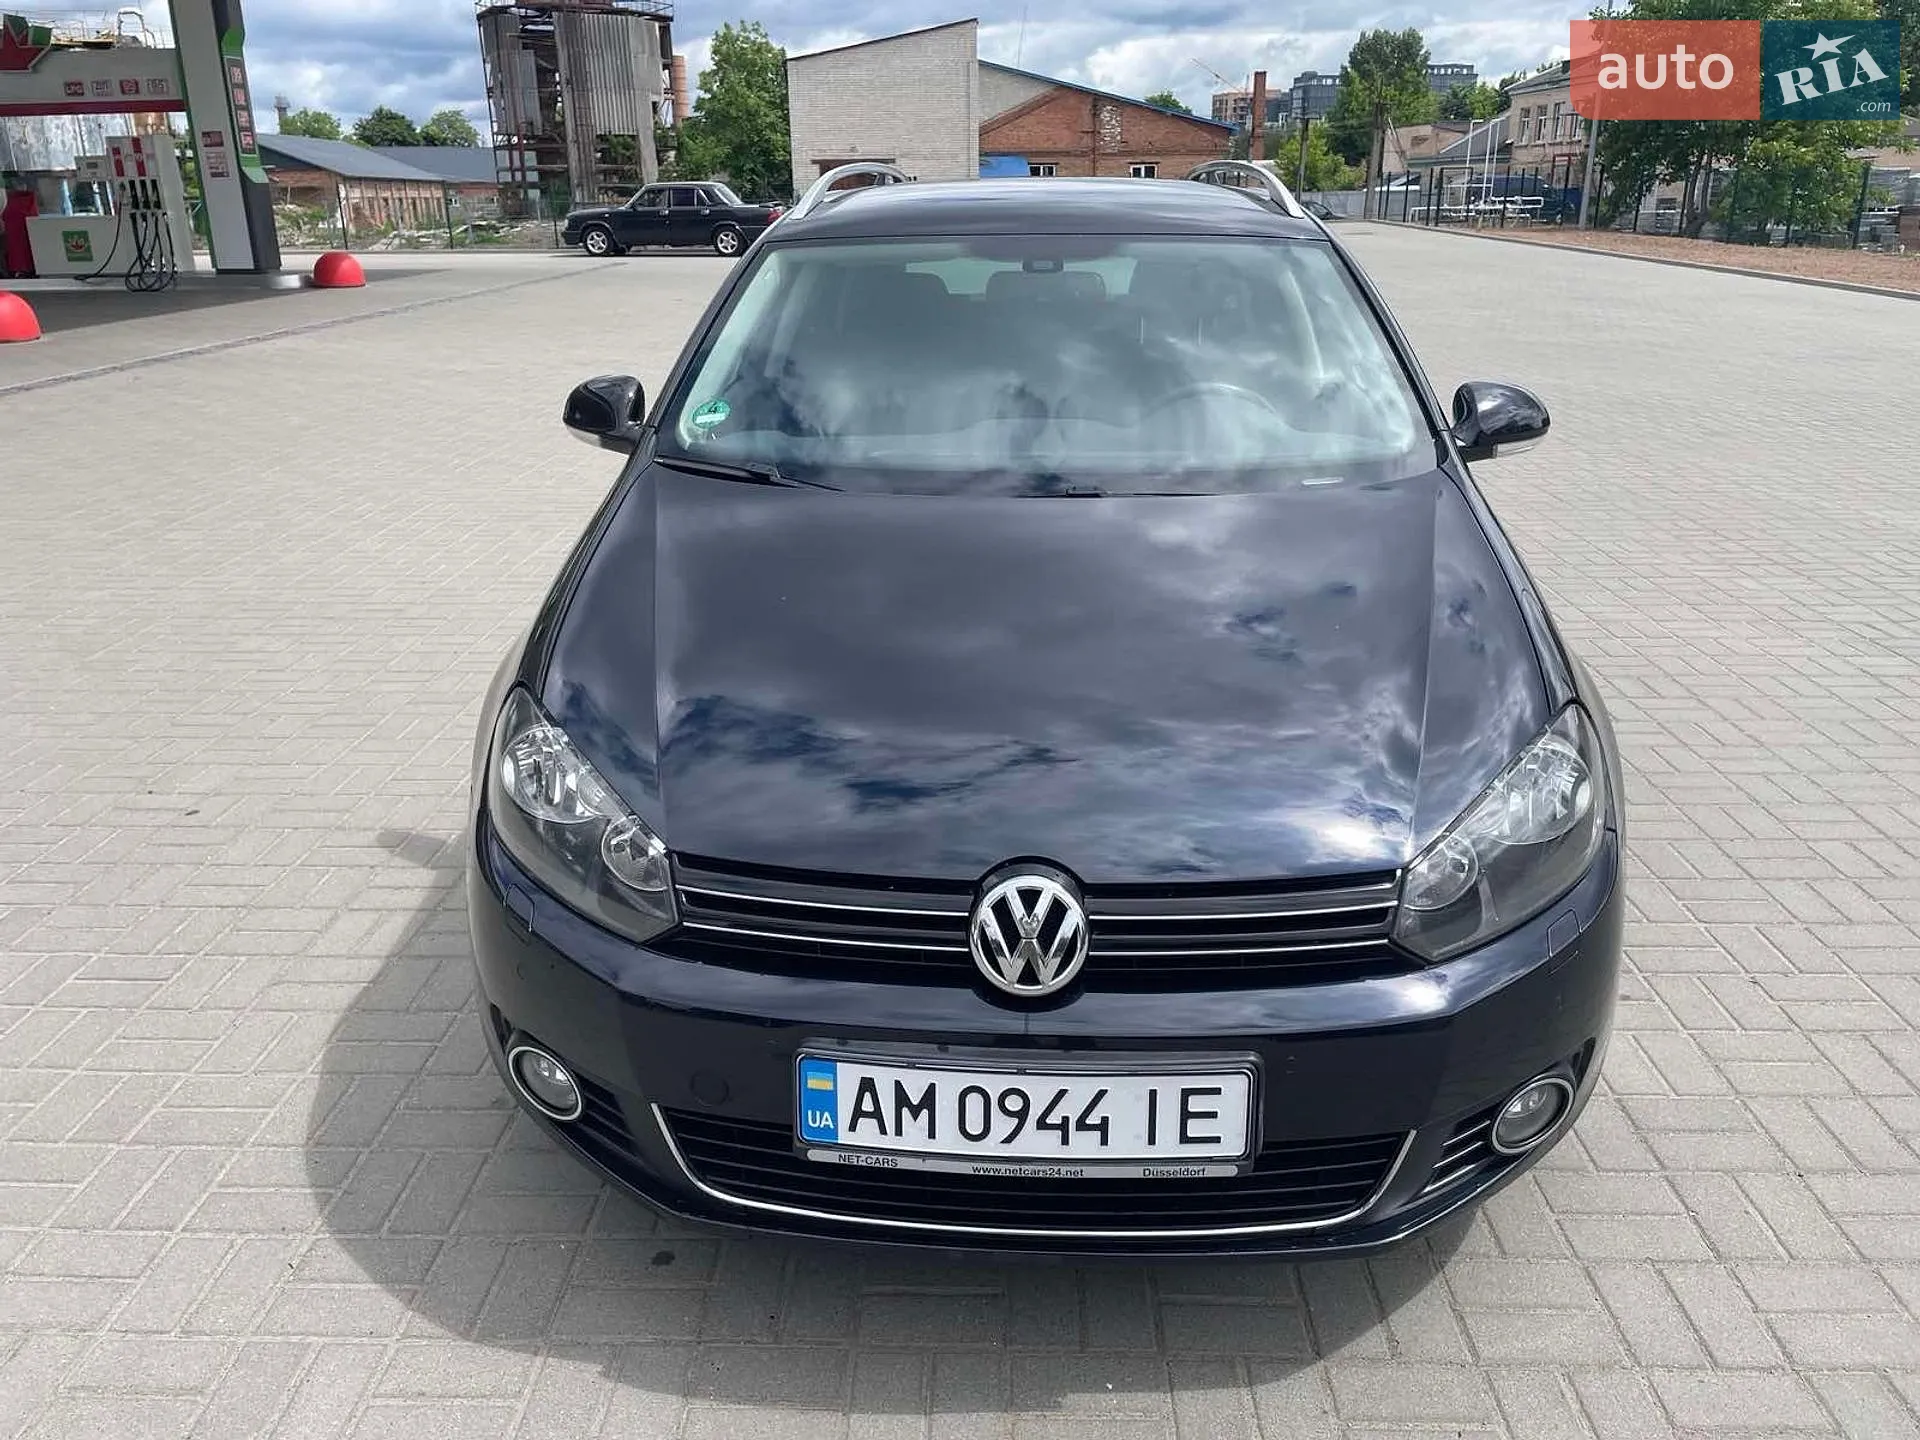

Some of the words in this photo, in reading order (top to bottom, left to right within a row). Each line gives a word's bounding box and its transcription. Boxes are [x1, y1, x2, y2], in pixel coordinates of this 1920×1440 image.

[807, 1109, 834, 1129] UA
[848, 1076, 936, 1140] AM
[958, 1085, 1109, 1147] 0944
[1147, 1087, 1222, 1146] IE
[838, 1154, 898, 1168] NET-CARS
[972, 1165, 1084, 1177] www.netcars24.net
